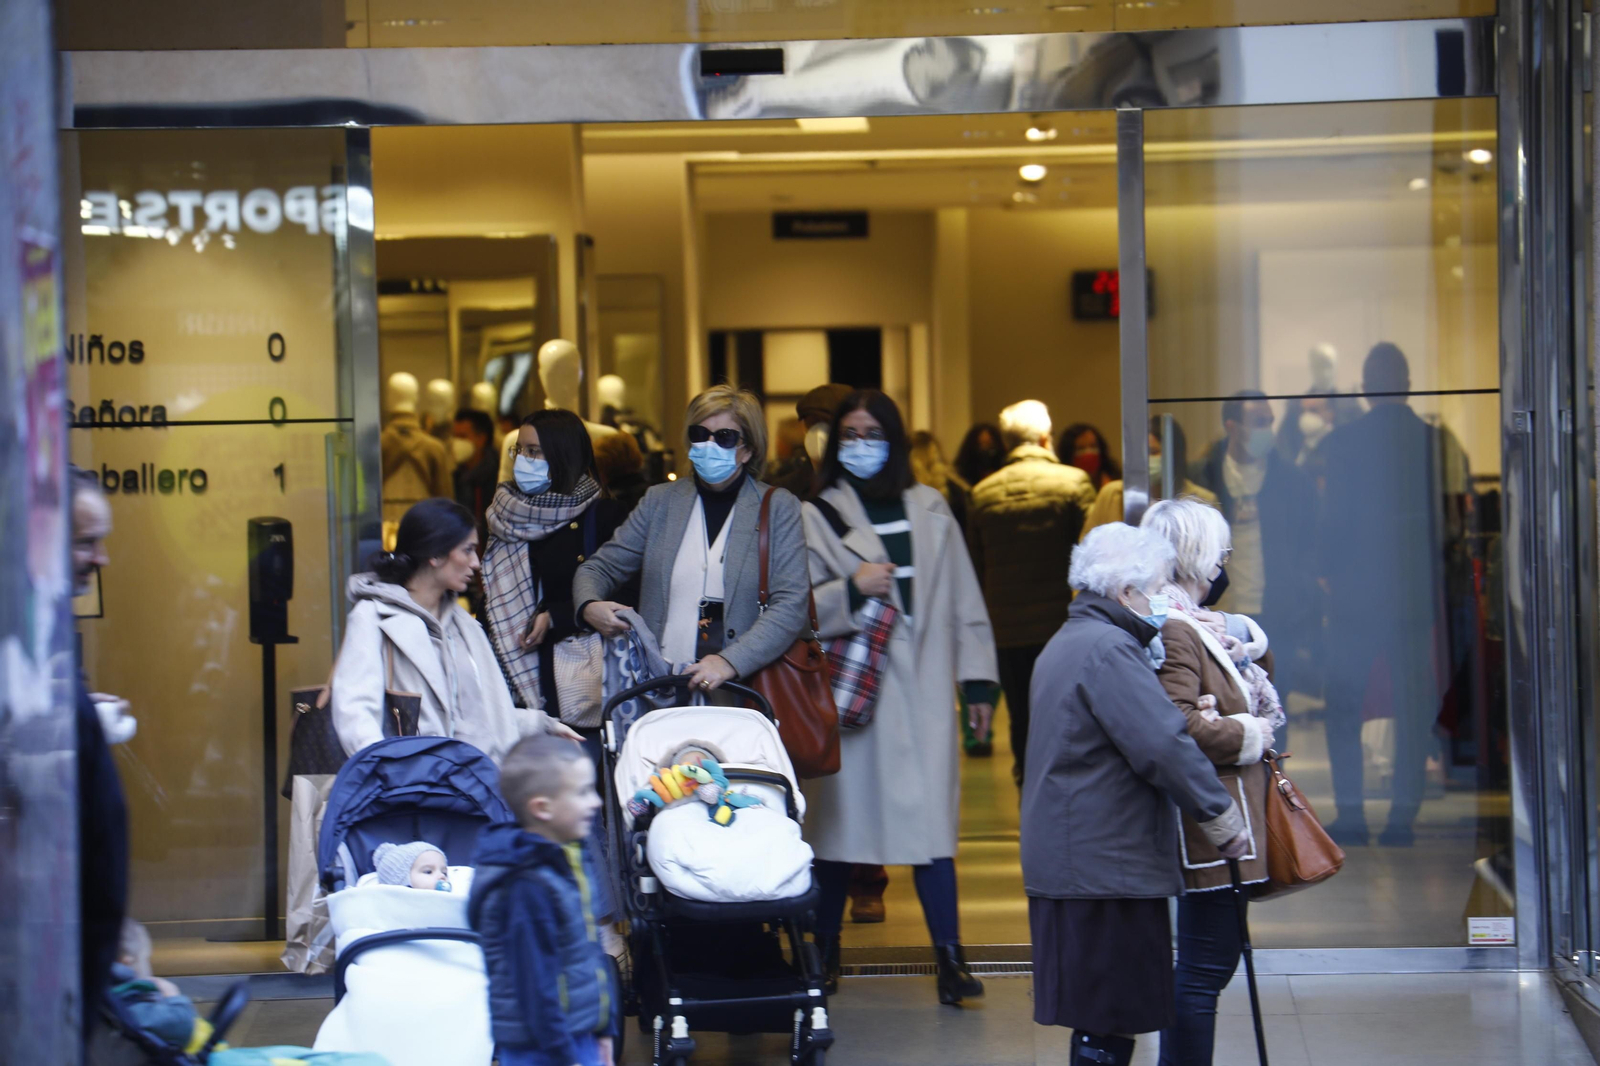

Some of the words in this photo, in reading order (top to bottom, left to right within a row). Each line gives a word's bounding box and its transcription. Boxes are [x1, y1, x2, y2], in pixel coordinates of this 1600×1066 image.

[267, 332, 286, 362] 0
[269, 396, 287, 427] 0
[273, 462, 286, 494] 1
